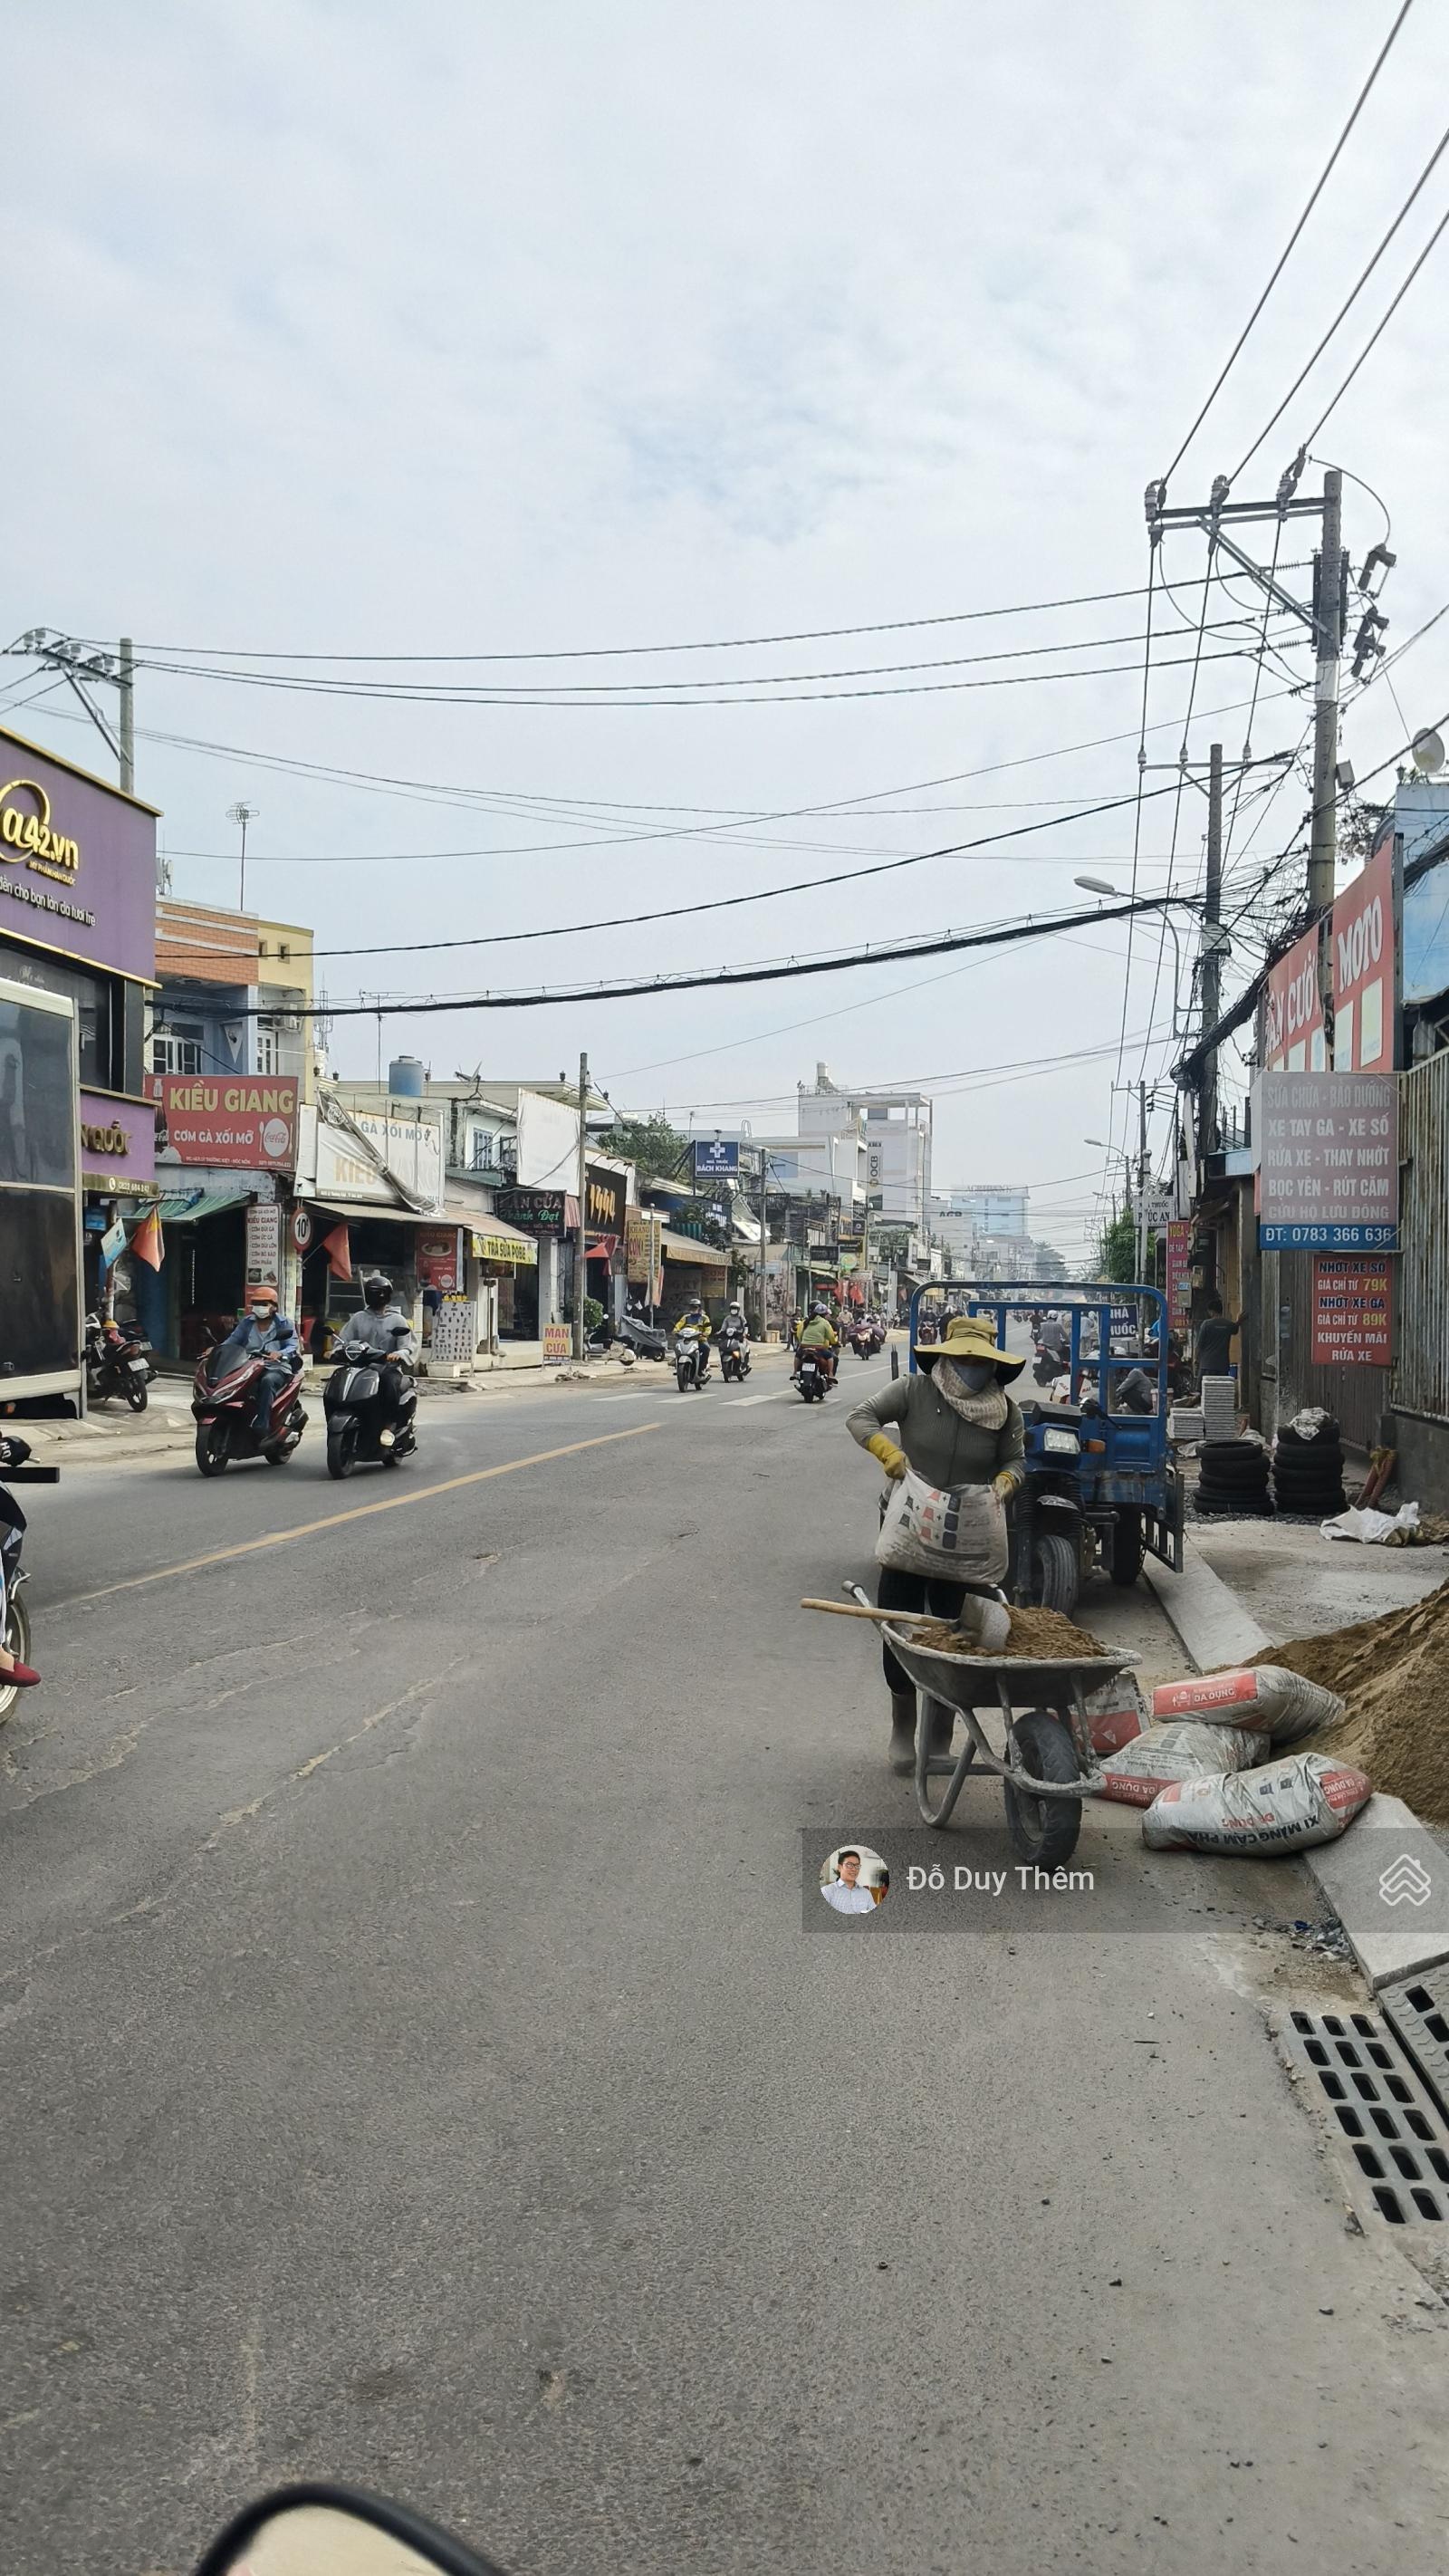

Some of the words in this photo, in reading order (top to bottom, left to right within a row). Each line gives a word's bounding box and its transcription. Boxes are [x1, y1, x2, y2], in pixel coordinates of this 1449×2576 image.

[14, 883, 29, 900] cho
[31, 888, 46, 908] bạn
[1338, 895, 1383, 994] MOTO
[169, 1080, 219, 1112] KIỀU
[225, 1089, 294, 1114] GIANG
[1330, 1079, 1351, 1108] BẢO
[361, 1120, 378, 1135] GÀ
[1268, 1119, 1285, 1137] XE
[1290, 1119, 1311, 1137] TAY
[1317, 1119, 1334, 1136] GA
[1348, 1119, 1366, 1136] XE
[1370, 1112, 1389, 1136] SỐ
[174, 1129, 197, 1143] CƠM
[198, 1128, 214, 1144] GÀ
[215, 1128, 234, 1145] XỐI
[235, 1129, 254, 1146] MỠ
[1268, 1143, 1292, 1167] RỬA
[1296, 1149, 1311, 1167] XE
[1324, 1149, 1353, 1167] THAY
[1358, 1145, 1389, 1167] NHỚT
[870, 1156, 878, 1177] OCB
[1269, 1178, 1293, 1200] BỌC
[1297, 1176, 1320, 1197] YÊN
[1333, 1176, 1357, 1197] RÚT
[1360, 1176, 1388, 1197] CĂM
[1138, 1209, 1157, 1222] PÚC
[1160, 1212, 1170, 1222] AN
[1300, 1203, 1318, 1222] HỘ
[1322, 1204, 1348, 1219] LƯU
[1351, 1204, 1389, 1222] ĐỘNG
[1169, 1225, 1185, 1237] YOGA
[1265, 1227, 1287, 1242] ĐT:
[1291, 1227, 1328, 1242] 0783
[1333, 1227, 1358, 1242] 366
[1365, 1227, 1391, 1242] 636
[487, 1239, 499, 1255] TRÀ
[1319, 1260, 1349, 1274] NHỚT
[1352, 1262, 1367, 1274] XE
[1370, 1259, 1387, 1274] SỐ
[1318, 1277, 1331, 1291] GIÁ
[1333, 1276, 1346, 1291] CHỈ
[1348, 1278, 1358, 1291] TỪ
[1363, 1278, 1387, 1291] 79K
[1319, 1294, 1349, 1309] NHỚT
[1352, 1297, 1367, 1309] XE
[1370, 1297, 1385, 1309] GA
[1318, 1312, 1330, 1325] GIÁ
[1332, 1311, 1346, 1325] CHỈ
[1348, 1313, 1358, 1325] TỪ
[1362, 1312, 1387, 1326] 89K
[1110, 1322, 1136, 1335] UỐC
[1318, 1329, 1361, 1343] KHUYẾN
[1365, 1331, 1387, 1343] MÃI
[1332, 1347, 1354, 1360] RỬA
[1358, 1350, 1372, 1361] XE
[1304, 1815, 1319, 1830] XI
[1259, 1821, 1302, 1842] MĂNG
